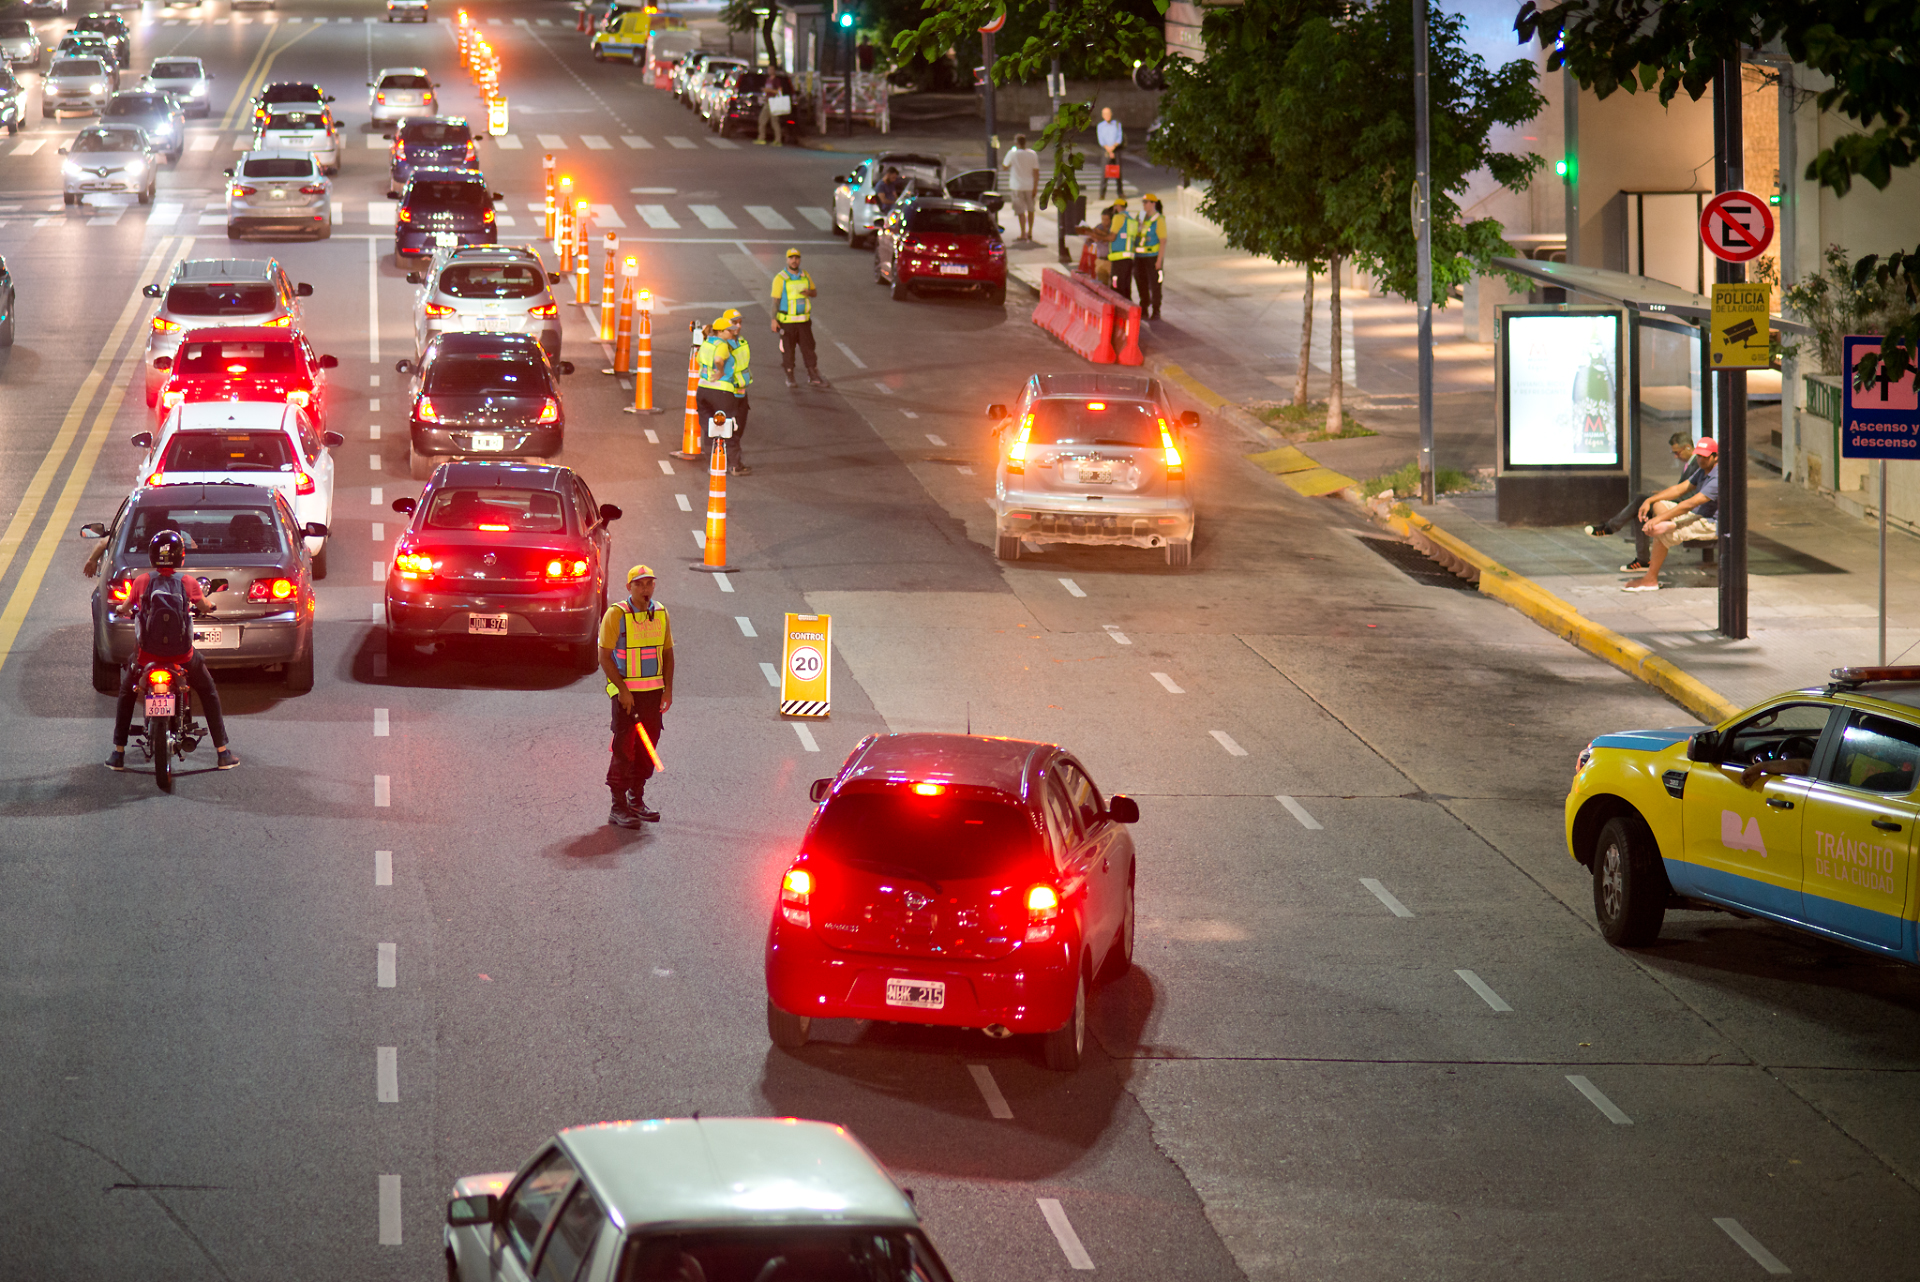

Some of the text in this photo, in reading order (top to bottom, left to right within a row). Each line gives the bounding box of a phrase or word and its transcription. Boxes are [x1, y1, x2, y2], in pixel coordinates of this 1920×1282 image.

[1722, 207, 1751, 247] E
[1716, 293, 1765, 305] POLICIA
[1716, 305, 1765, 313] DE LA CIUDAD
[1849, 420, 1920, 435] Ascenso y
[1852, 436, 1917, 448] descenso
[490, 619, 506, 629] 974
[204, 632, 221, 643] 568
[790, 632, 825, 641] CONTROL
[795, 657, 818, 671] 20
[1721, 809, 1767, 858] BA
[1815, 830, 1894, 873] TRÁNSITO
[1816, 857, 1894, 894] DE LA CIUDAD
[918, 987, 942, 1004] 215
